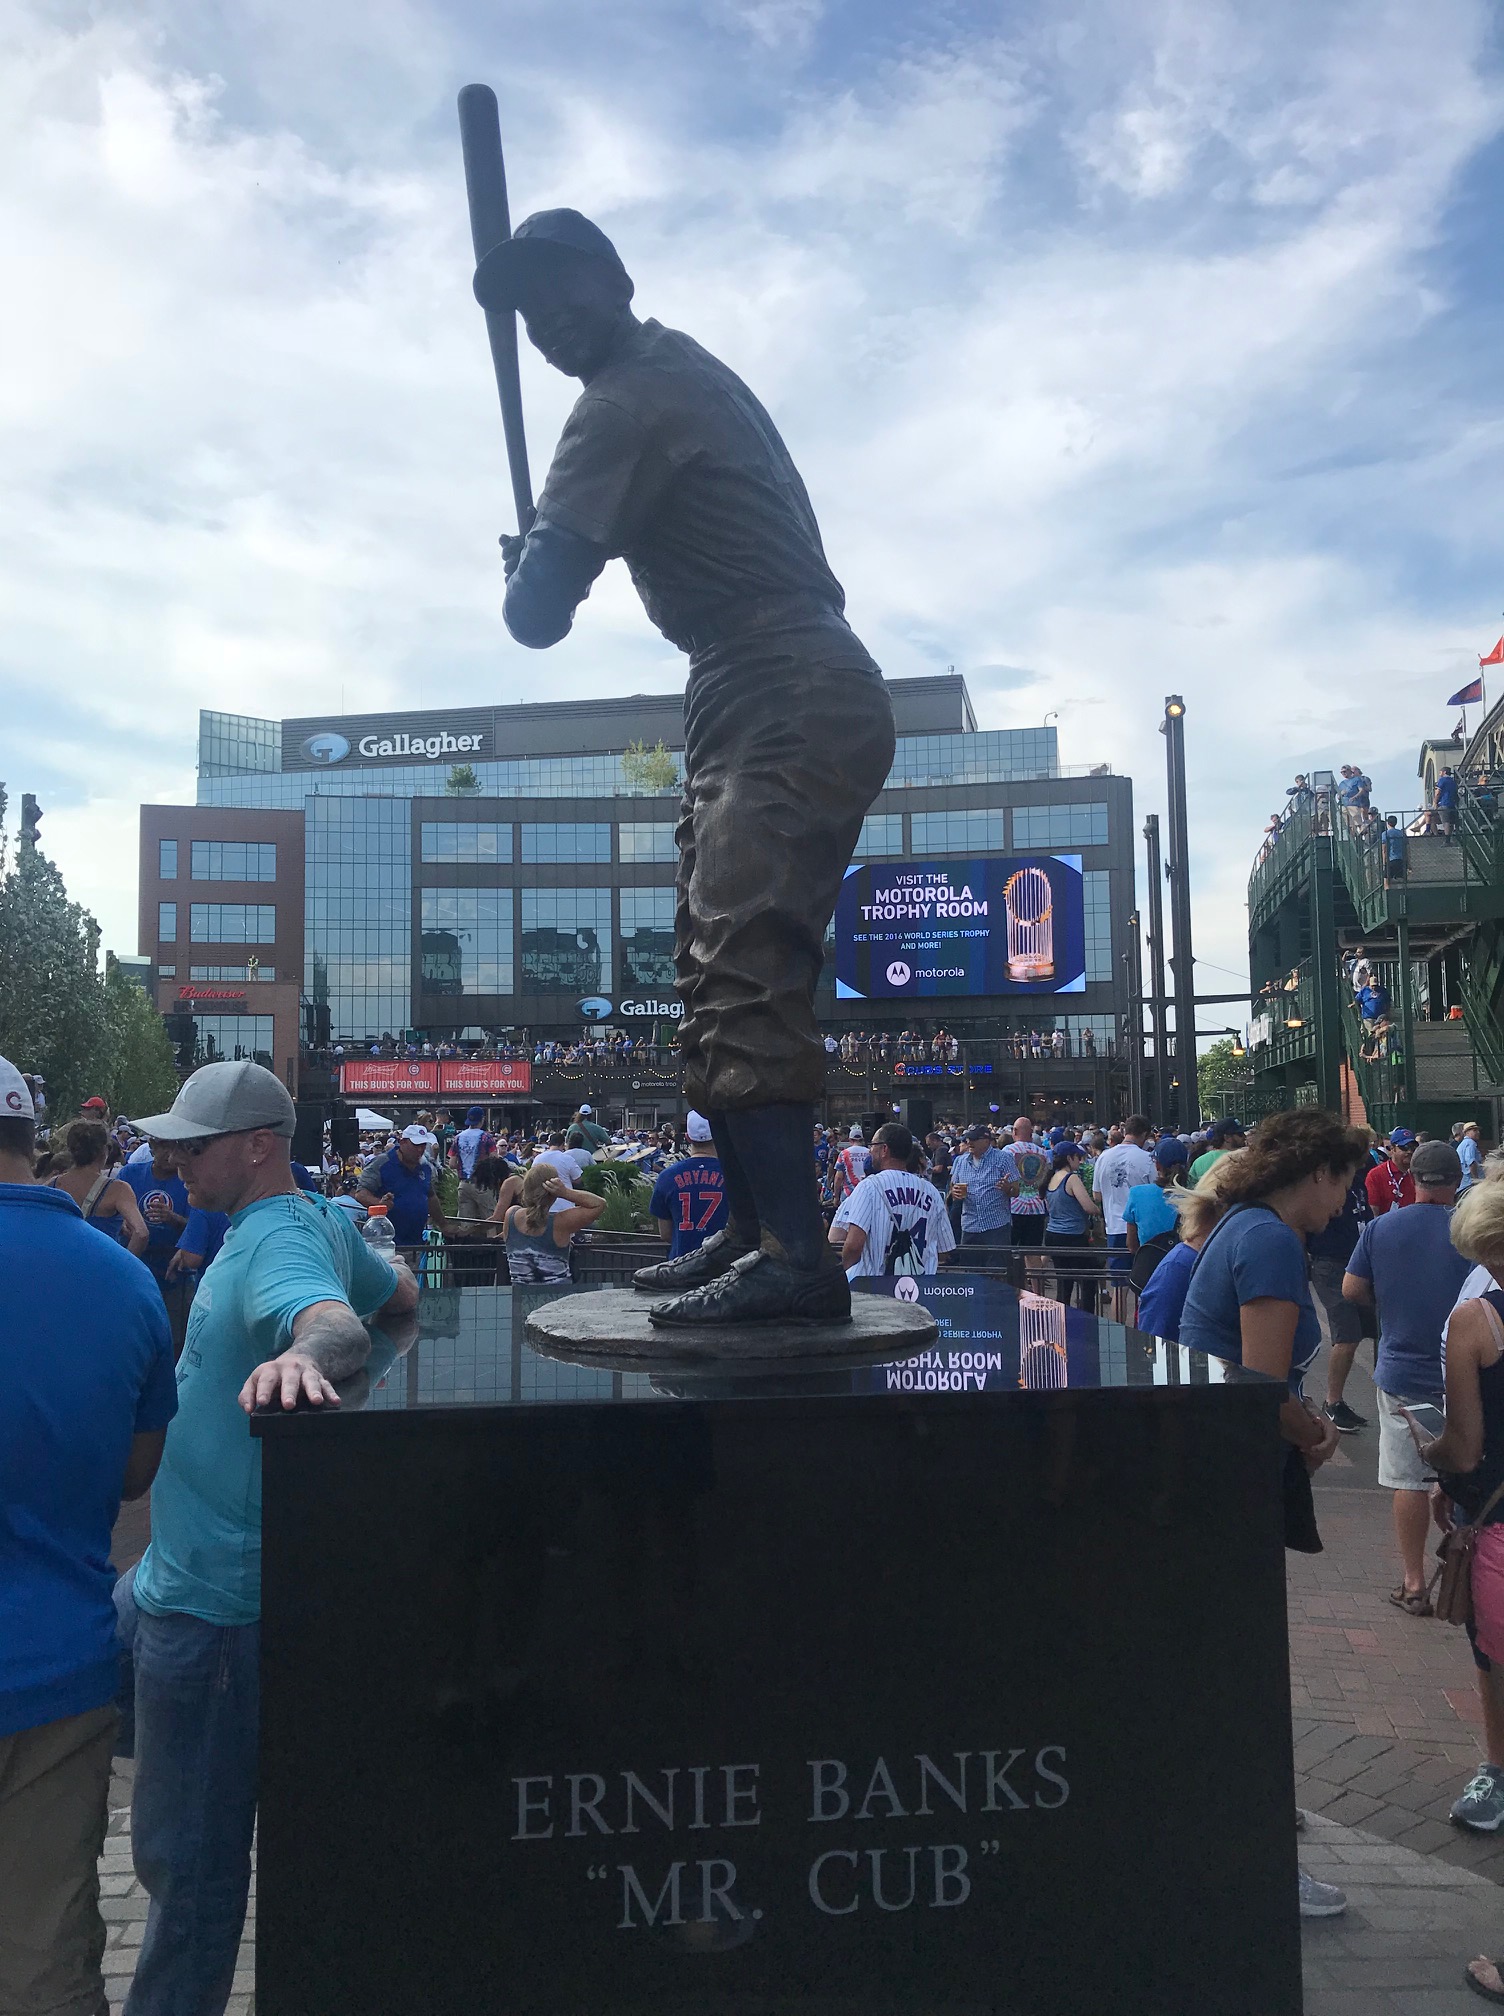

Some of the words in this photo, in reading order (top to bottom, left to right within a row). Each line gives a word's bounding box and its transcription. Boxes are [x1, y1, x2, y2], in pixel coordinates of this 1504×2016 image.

[358, 731, 484, 759] Gallagher
[896, 875, 924, 886] VISIT
[926, 873, 948, 884] THE
[875, 885, 973, 904] MOTOROLA
[861, 903, 932, 921] TROPHY
[936, 901, 988, 918] ROOM
[853, 934, 868, 942] SEE
[869, 933, 884, 941] THE
[885, 933, 903, 941] 2016
[904, 932, 931, 940] WORLD
[932, 931, 959, 939] SERIES
[960, 929, 990, 938] TROPHY
[900, 942, 916, 950] AND
[918, 942, 942, 950] MORE!
[915, 966, 965, 978] motorola
[178, 985, 246, 999] Budweiser
[350, 1080, 368, 1090] THIS
[370, 1080, 395, 1090] BUD'S
[397, 1080, 412, 1090] FOR
[413, 1080, 432, 1089] YOU.
[445, 1080, 463, 1089] THIS
[465, 1080, 488, 1089] BUD'S
[490, 1080, 505, 1089] FOR
[507, 1080, 525, 1089] YOU.
[640, 1080, 665, 1088] motorola
[665, 1080, 677, 1088] trop
[679, 1191, 723, 1231] 17
[510, 1763, 762, 1840] ERNIE
[806, 1745, 1071, 1822] BANKS
